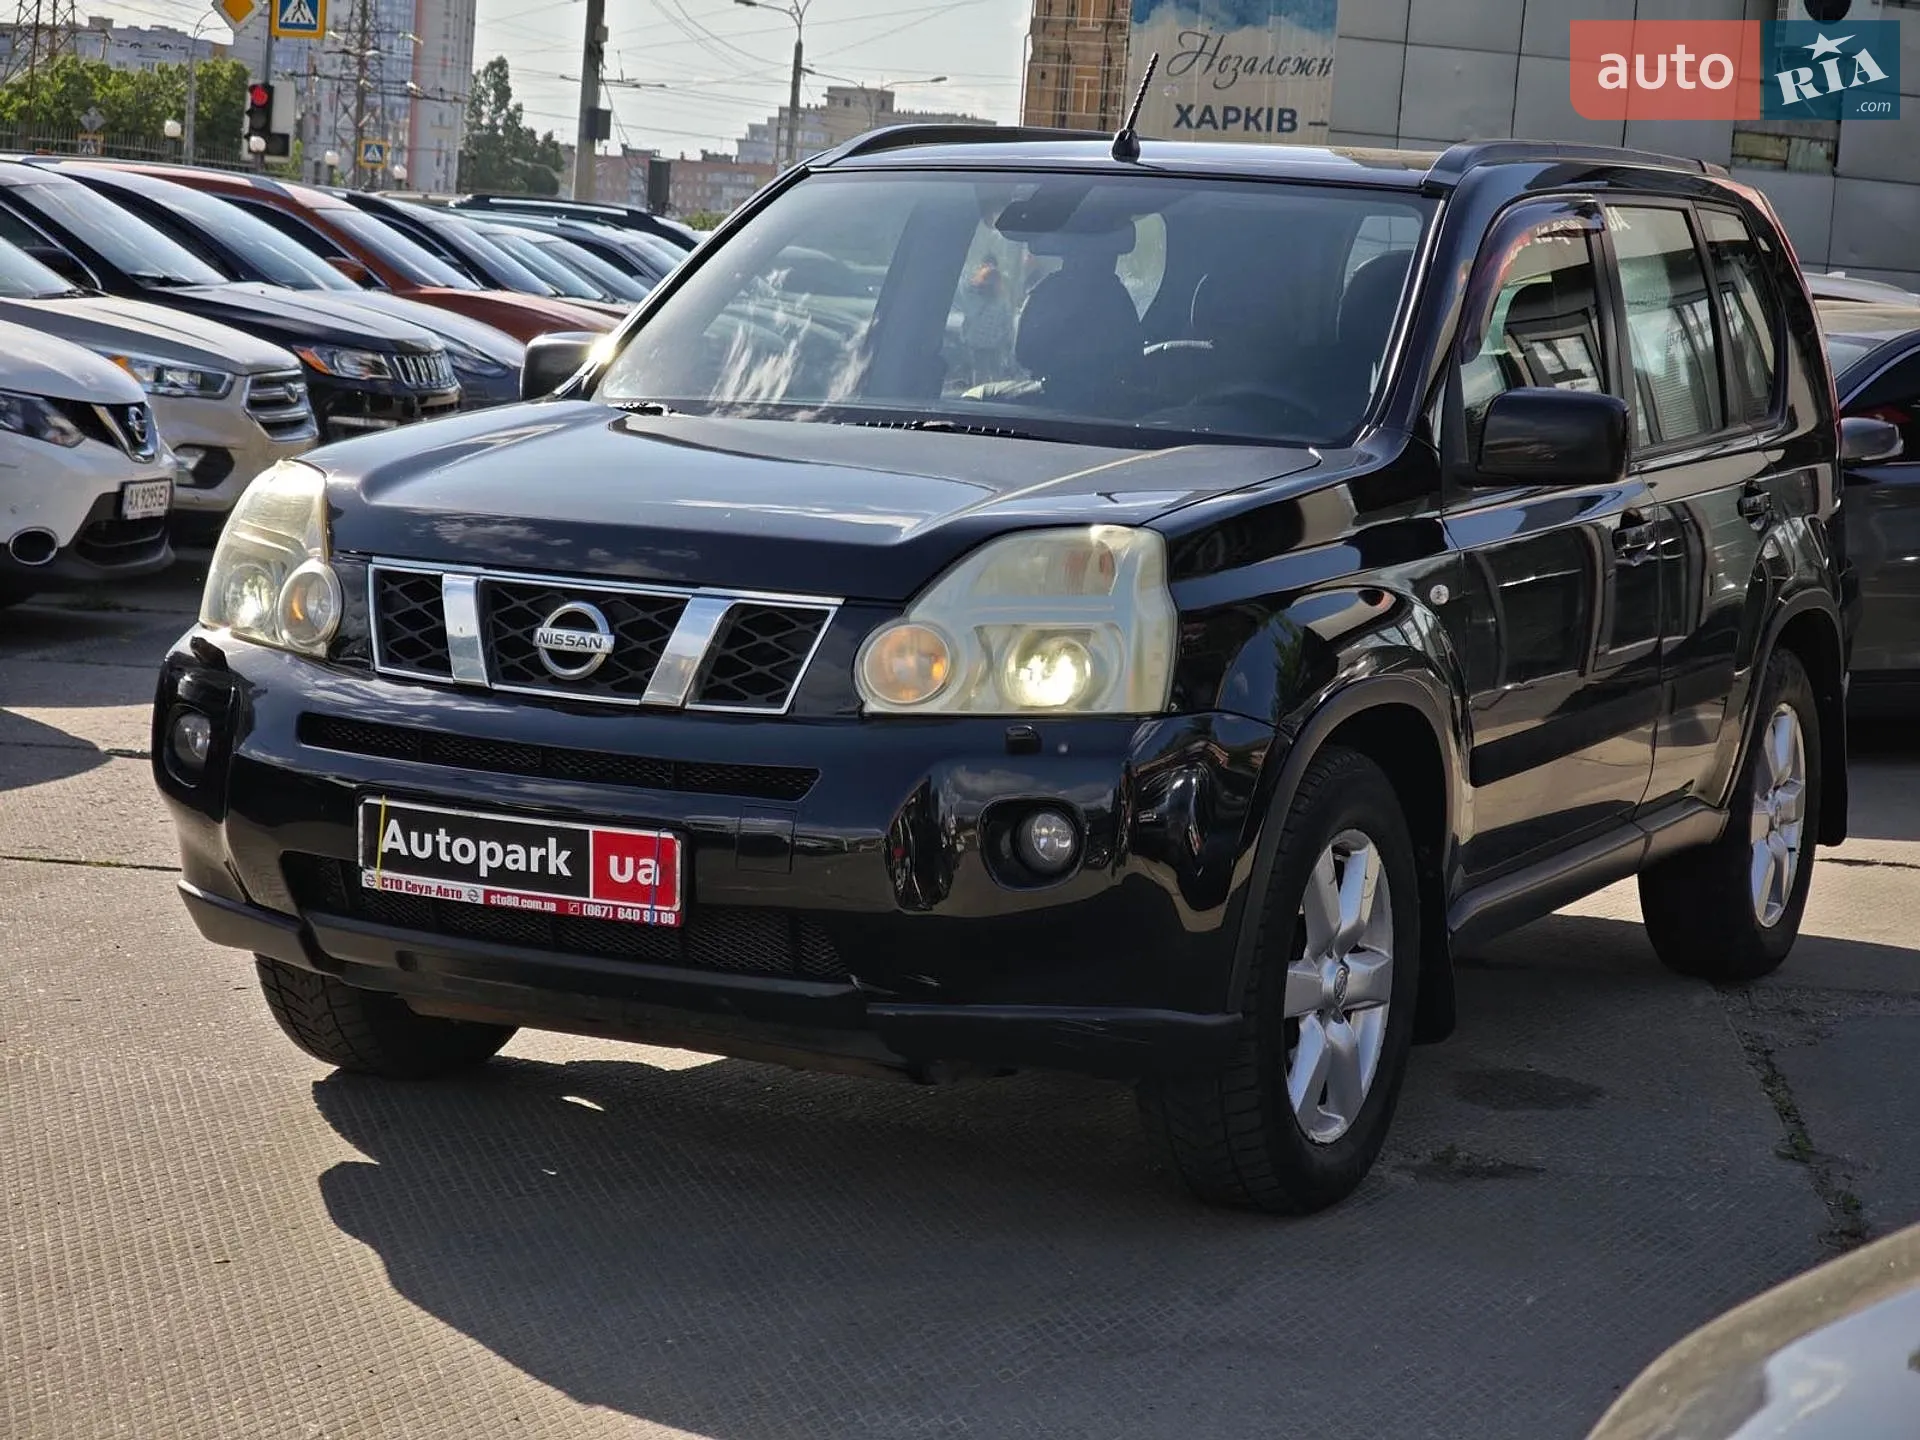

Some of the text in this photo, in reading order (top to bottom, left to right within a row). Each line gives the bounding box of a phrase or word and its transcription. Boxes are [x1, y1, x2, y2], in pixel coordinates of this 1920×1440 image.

[1173, 103, 1298, 134] ХАРКІВ
[538, 632, 603, 649] NISSAN
[382, 818, 660, 885] Autopark ua
